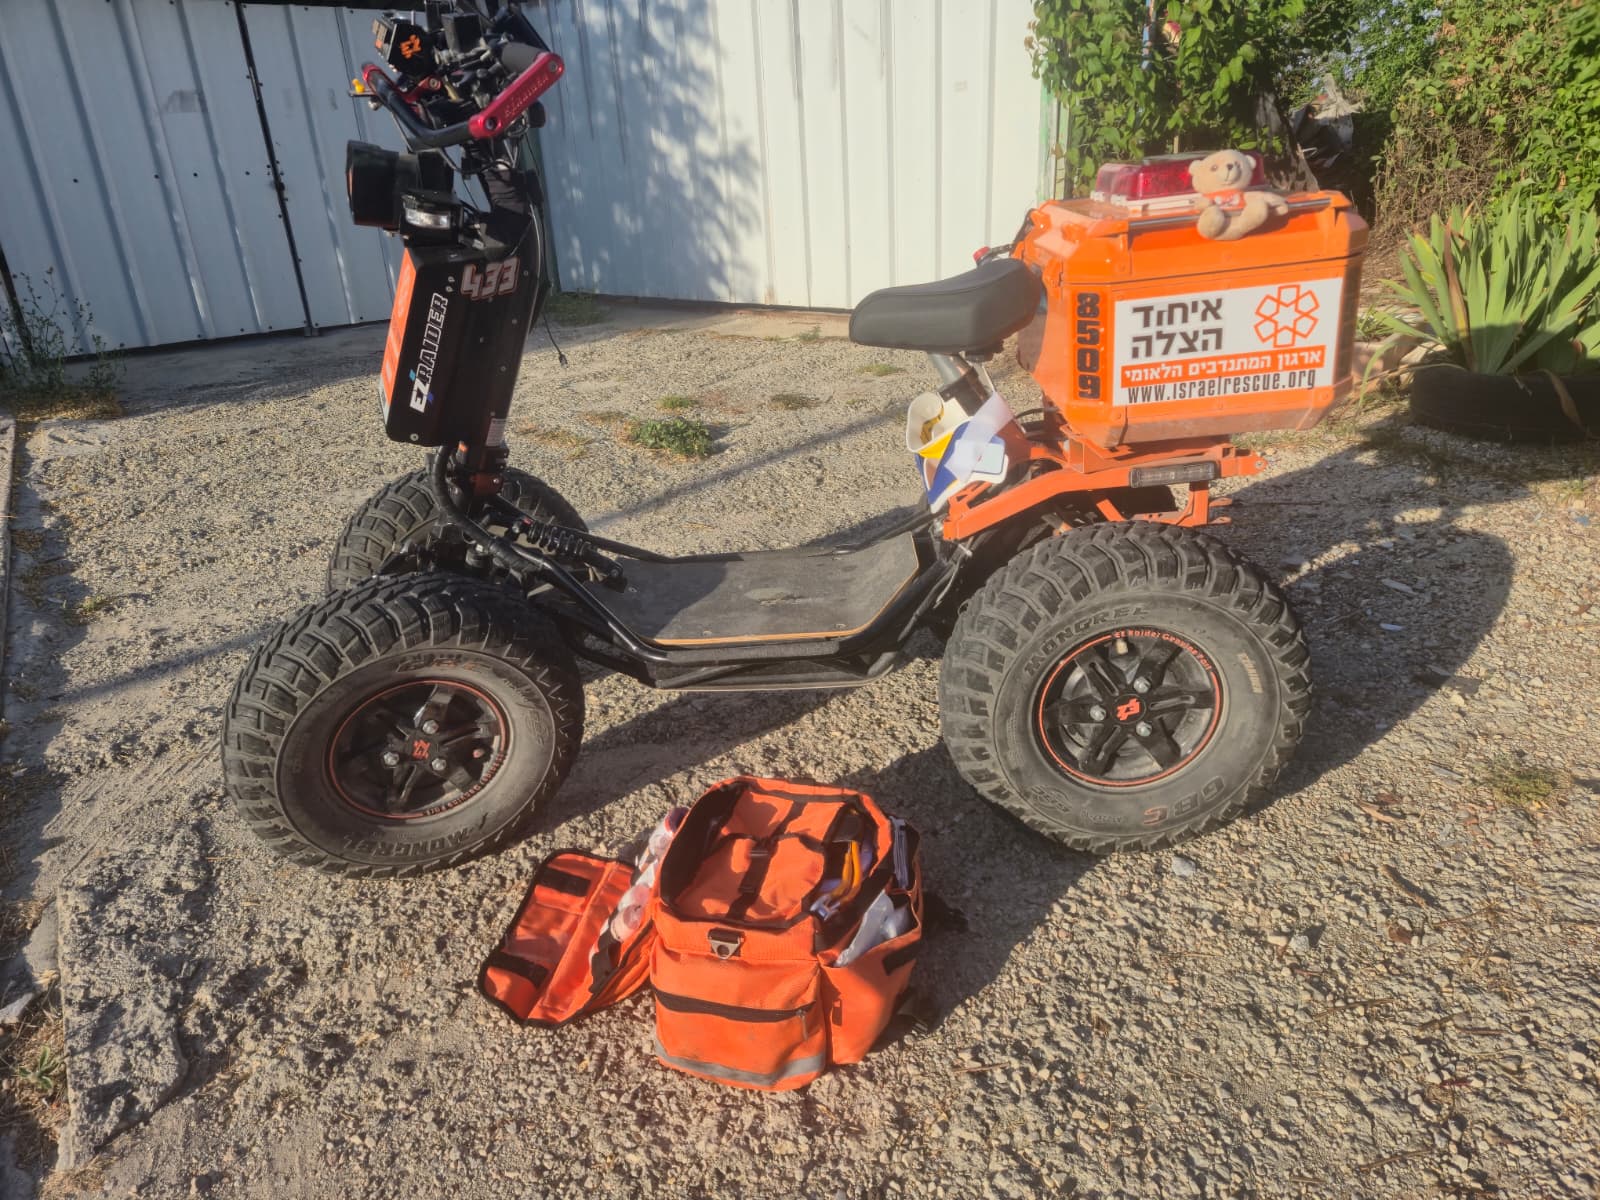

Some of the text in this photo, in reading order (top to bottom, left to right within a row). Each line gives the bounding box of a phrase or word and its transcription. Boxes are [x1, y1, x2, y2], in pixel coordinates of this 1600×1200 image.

[460, 256, 521, 300] 433
[1132, 297, 1223, 328] איחוד
[1077, 293, 1101, 399] 8509
[1131, 327, 1223, 359] הצלה
[1124, 350, 1322, 382] ארגון המתנדבים הלאומי
[1127, 370, 1316, 403] www.israelrescue.org
[1024, 606, 1150, 676] MONGREL
